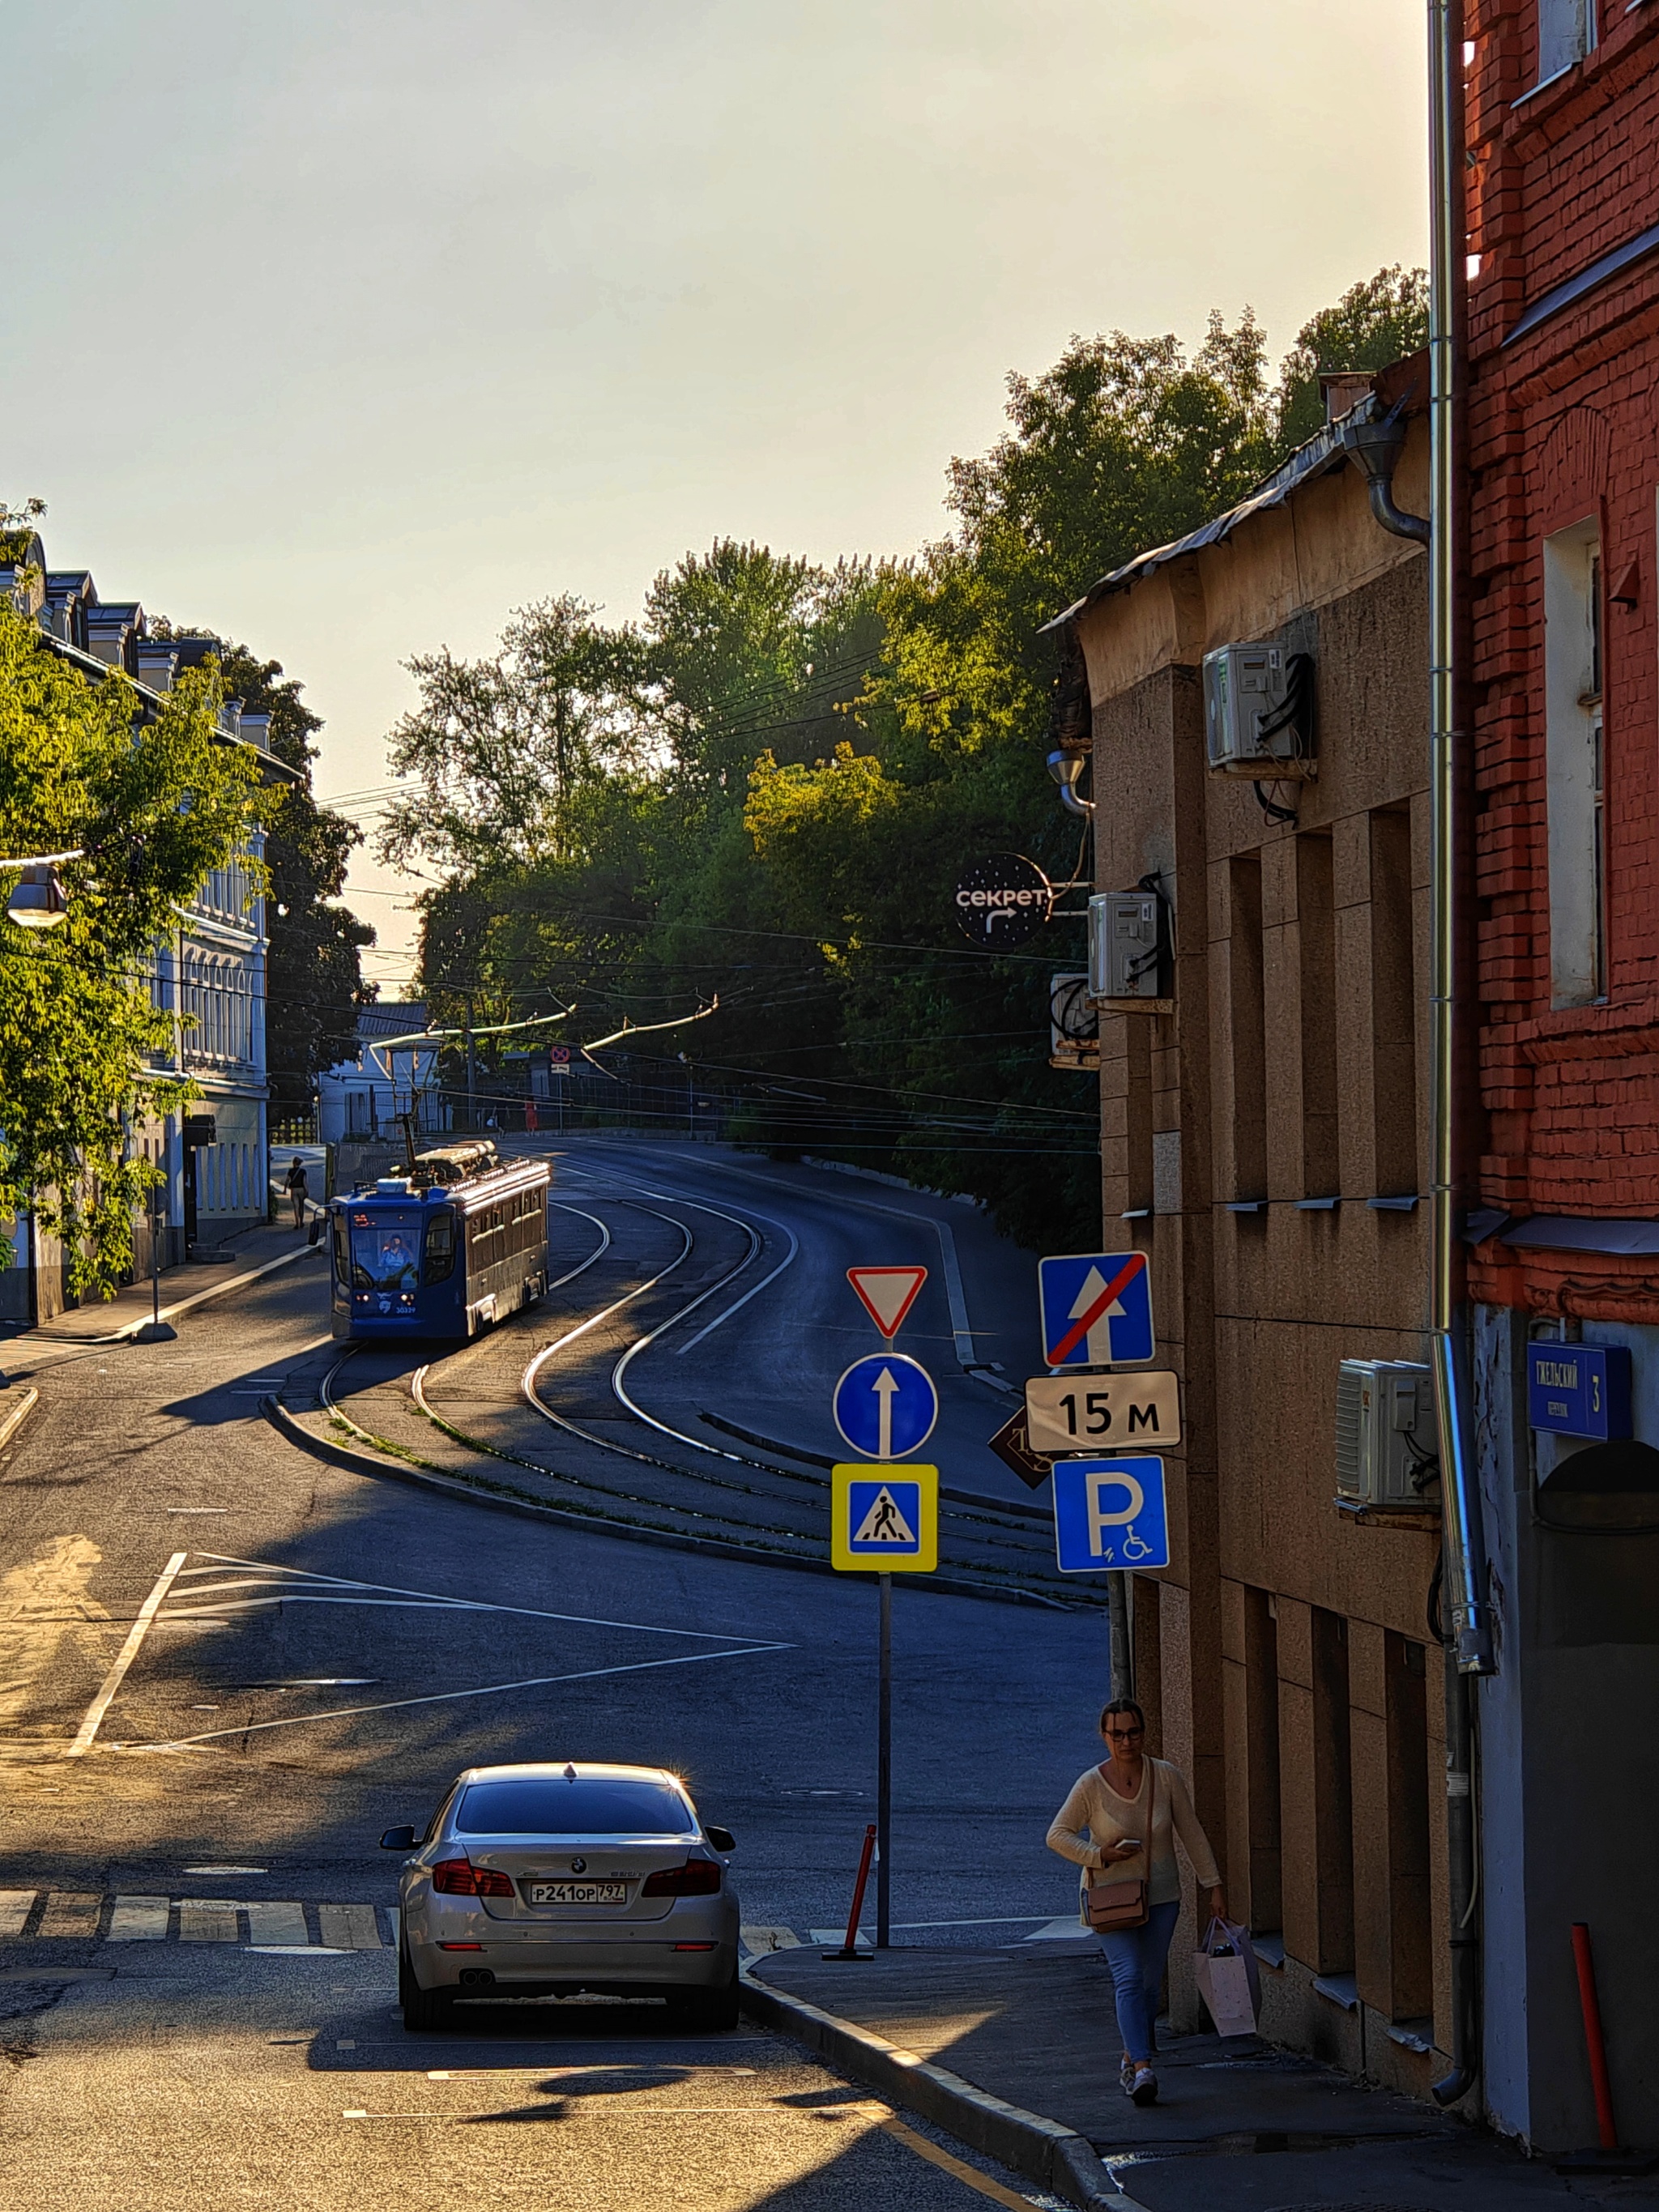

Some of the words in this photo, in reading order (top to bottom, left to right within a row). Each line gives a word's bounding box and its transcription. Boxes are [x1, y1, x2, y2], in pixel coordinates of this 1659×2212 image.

[1536, 1359, 1577, 1390] ГЖЕЛЬСКИЙ
[1592, 1375, 1600, 1413] 3
[1060, 1392, 1111, 1435] 15
[1085, 1472, 1144, 1557] P
[598, 1885, 621, 1897] 797
